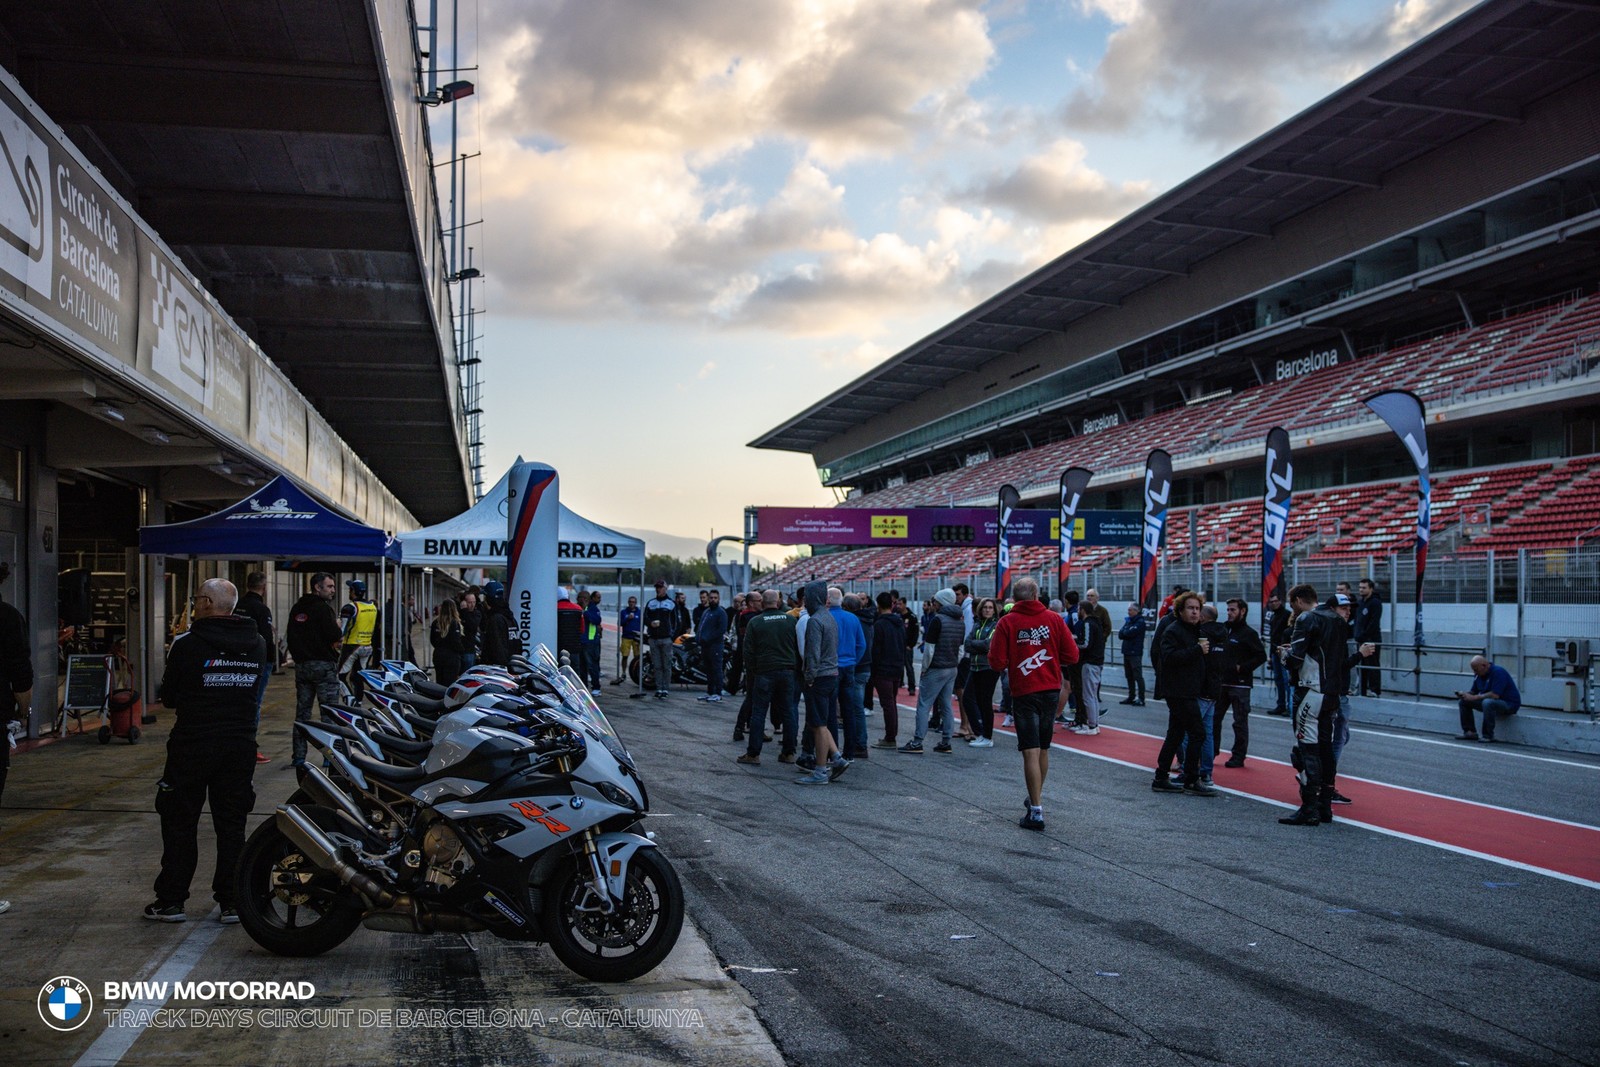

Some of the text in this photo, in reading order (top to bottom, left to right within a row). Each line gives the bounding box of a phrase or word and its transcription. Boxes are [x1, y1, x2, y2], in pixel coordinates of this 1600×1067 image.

[57, 164, 118, 255] Circuit de
[60, 216, 119, 301] Barcelona
[58, 274, 119, 345] CATALUNYA
[1276, 349, 1339, 380] Barcelona
[1083, 411, 1119, 434] Barcelona
[424, 538, 618, 559] BMW MRRAD
[222, 660, 259, 668] Motorsport
[203, 672, 258, 684] TECMAS
